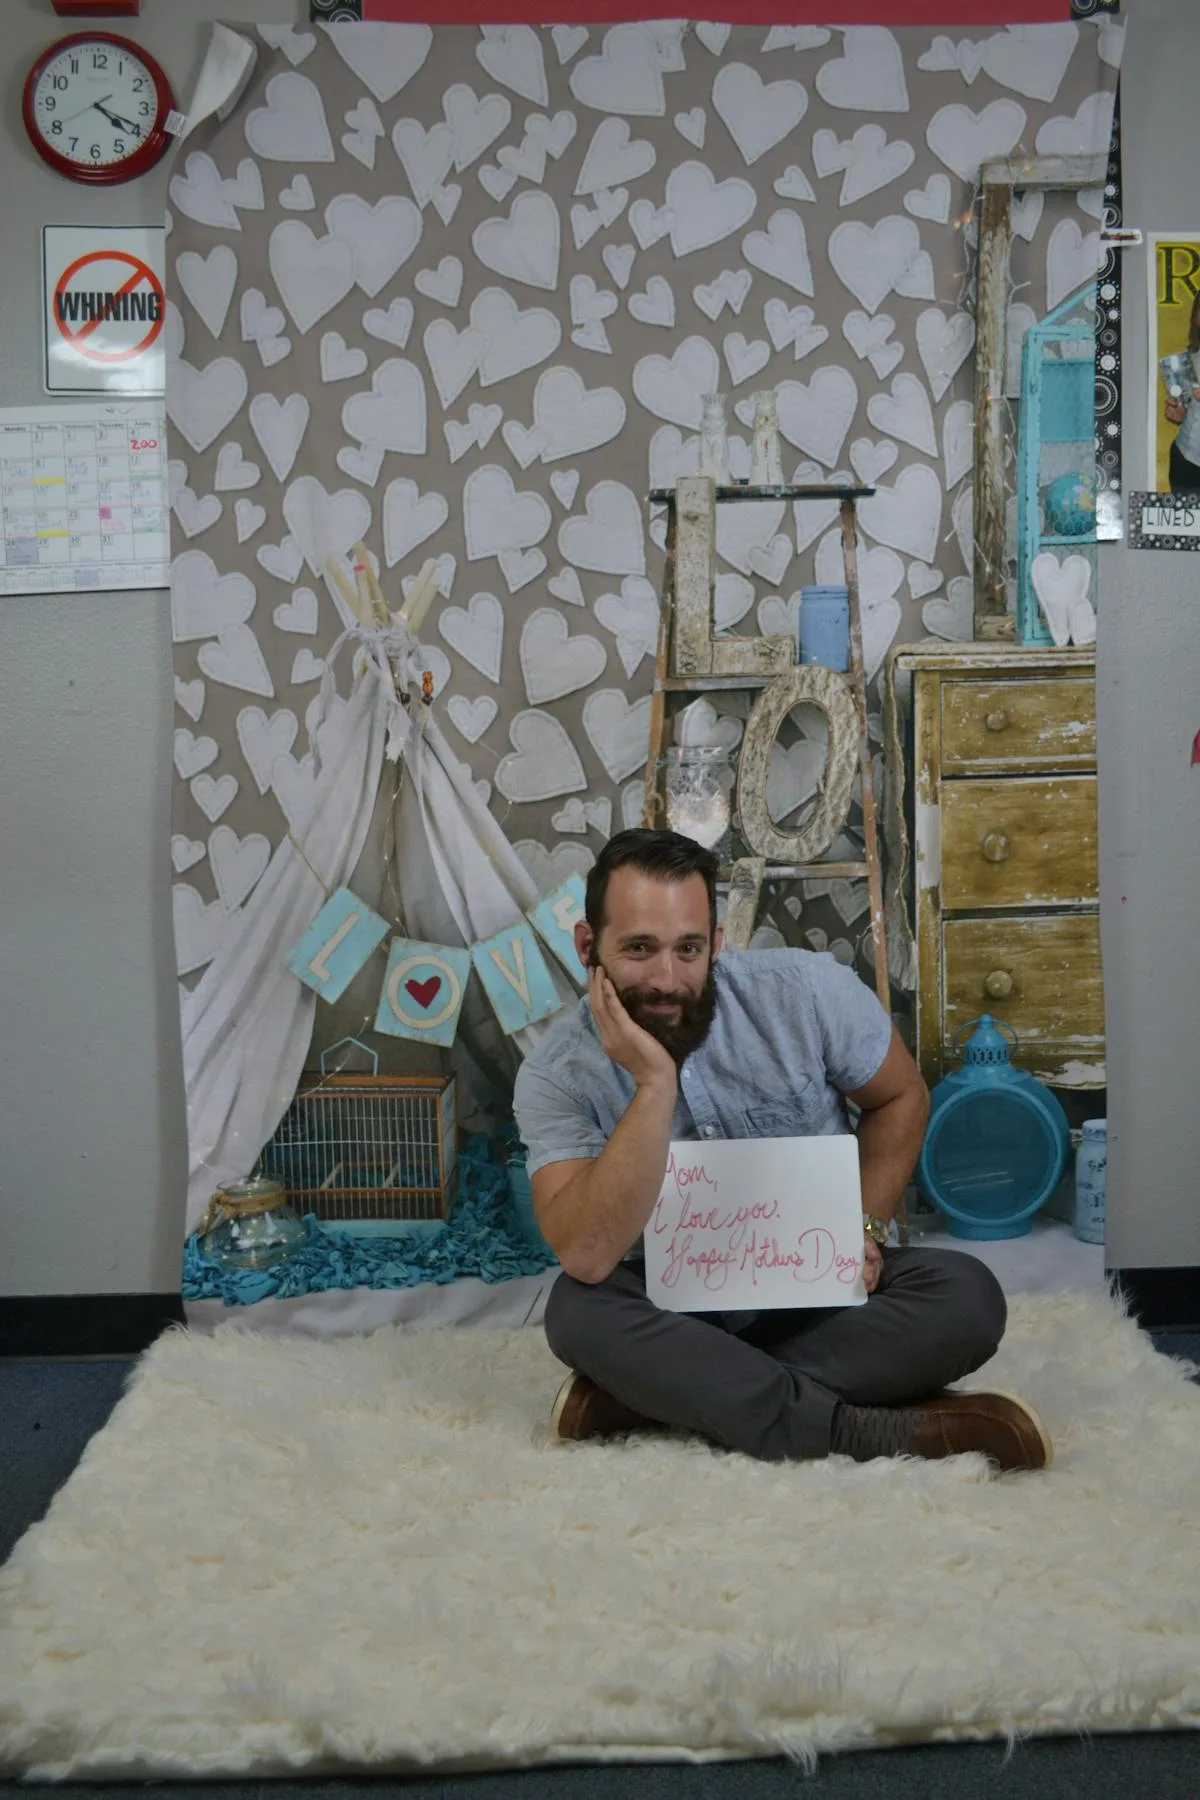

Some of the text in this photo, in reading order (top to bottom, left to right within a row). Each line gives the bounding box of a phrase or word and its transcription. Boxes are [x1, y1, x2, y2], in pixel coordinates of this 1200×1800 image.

[71, 59, 79, 74] 11
[93, 54, 107, 69] 12
[52, 75, 68, 91] 10
[132, 78, 143, 92] 2
[45, 96, 56, 111] 9
[138, 101, 149, 116] 3
[51, 119, 63, 135] 8
[131, 124, 141, 138] 4
[68, 136, 79, 151] 7
[113, 138, 125, 153] 5
[90, 144, 101, 159] 6
[56, 292, 162, 322] WHINING
[1146, 508, 1195, 528] LINED
[674, 1191, 732, 1232] love
[727, 1199, 781, 1251] you.
[661, 1233, 738, 1292] Happy
[792, 1227, 861, 1285] Day
